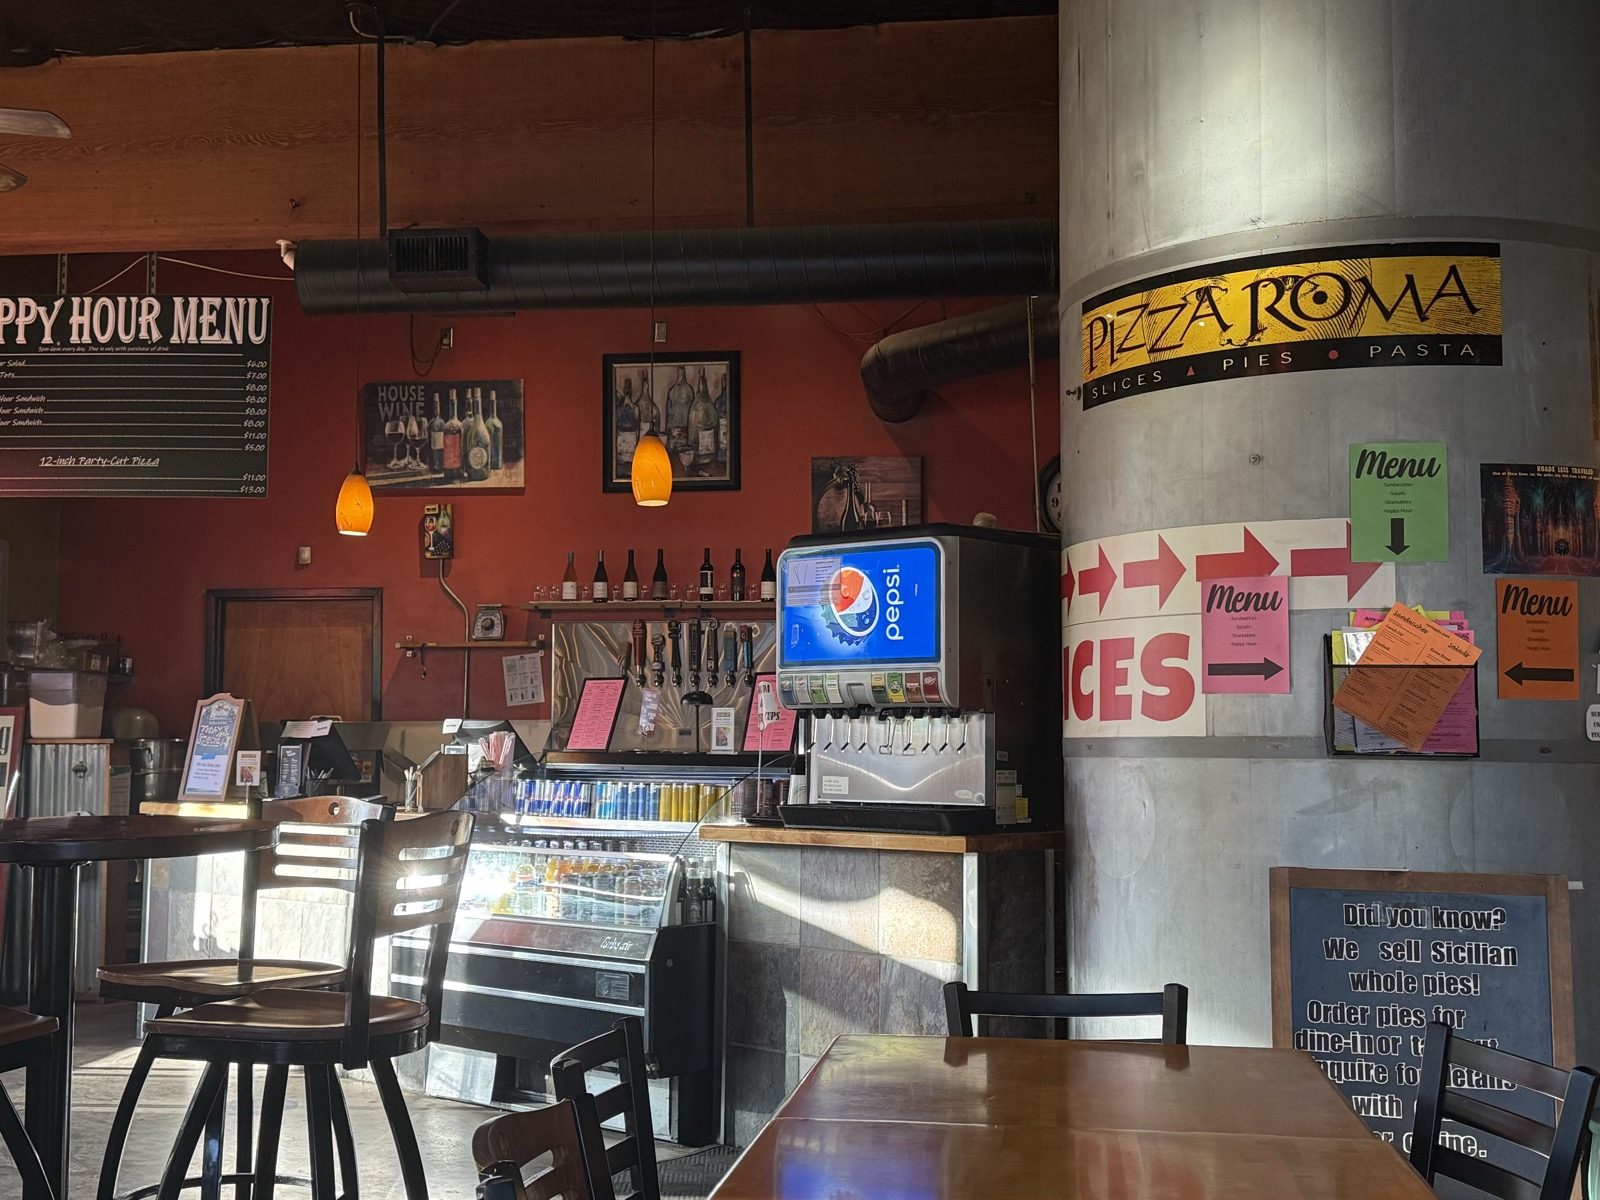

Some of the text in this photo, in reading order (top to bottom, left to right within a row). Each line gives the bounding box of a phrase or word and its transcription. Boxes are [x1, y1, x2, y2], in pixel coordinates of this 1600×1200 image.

[69, 297, 163, 344] HOUR
[170, 297, 270, 345] MENU
[1086, 264, 1481, 374] PIZZA ROMA
[246, 360, 267, 368] $6.00
[246, 372, 267, 380] $7.00
[1092, 344, 1476, 400] SLICES PIES PASTA
[246, 383, 267, 392] $8.00
[378, 386, 425, 401] HOUSE
[12, 418, 42, 426] Sandwich
[245, 408, 267, 416] $8.00
[378, 402, 425, 422] WINE
[244, 431, 266, 440] $11.00
[244, 443, 265, 452] $5.00
[40, 456, 160, 467] 12-inch Party-Cut Pizza
[1356, 449, 1441, 479] Menu
[240, 485, 265, 493] $13.00
[242, 473, 266, 481] $11.00
[1052, 497, 1059, 508] 9
[882, 568, 904, 640] pepsi
[1207, 584, 1283, 613] Menu
[1502, 584, 1573, 616] Menu
[1393, 610, 1428, 634] Sandwiches
[1448, 642, 1471, 658] Salads
[1064, 632, 1195, 722] ICES
[1344, 904, 1506, 930] Did you know?
[1322, 938, 1518, 966] We sell Sicilian
[1349, 969, 1480, 996] whole pies!
[1307, 1000, 1466, 1029] Order pies for
[1294, 1029, 1374, 1054] dine-in
[1377, 1034, 1402, 1056] or
[1312, 1056, 1388, 1083] nquire
[1396, 1063, 1421, 1086] fo
[1352, 1094, 1402, 1118] with
